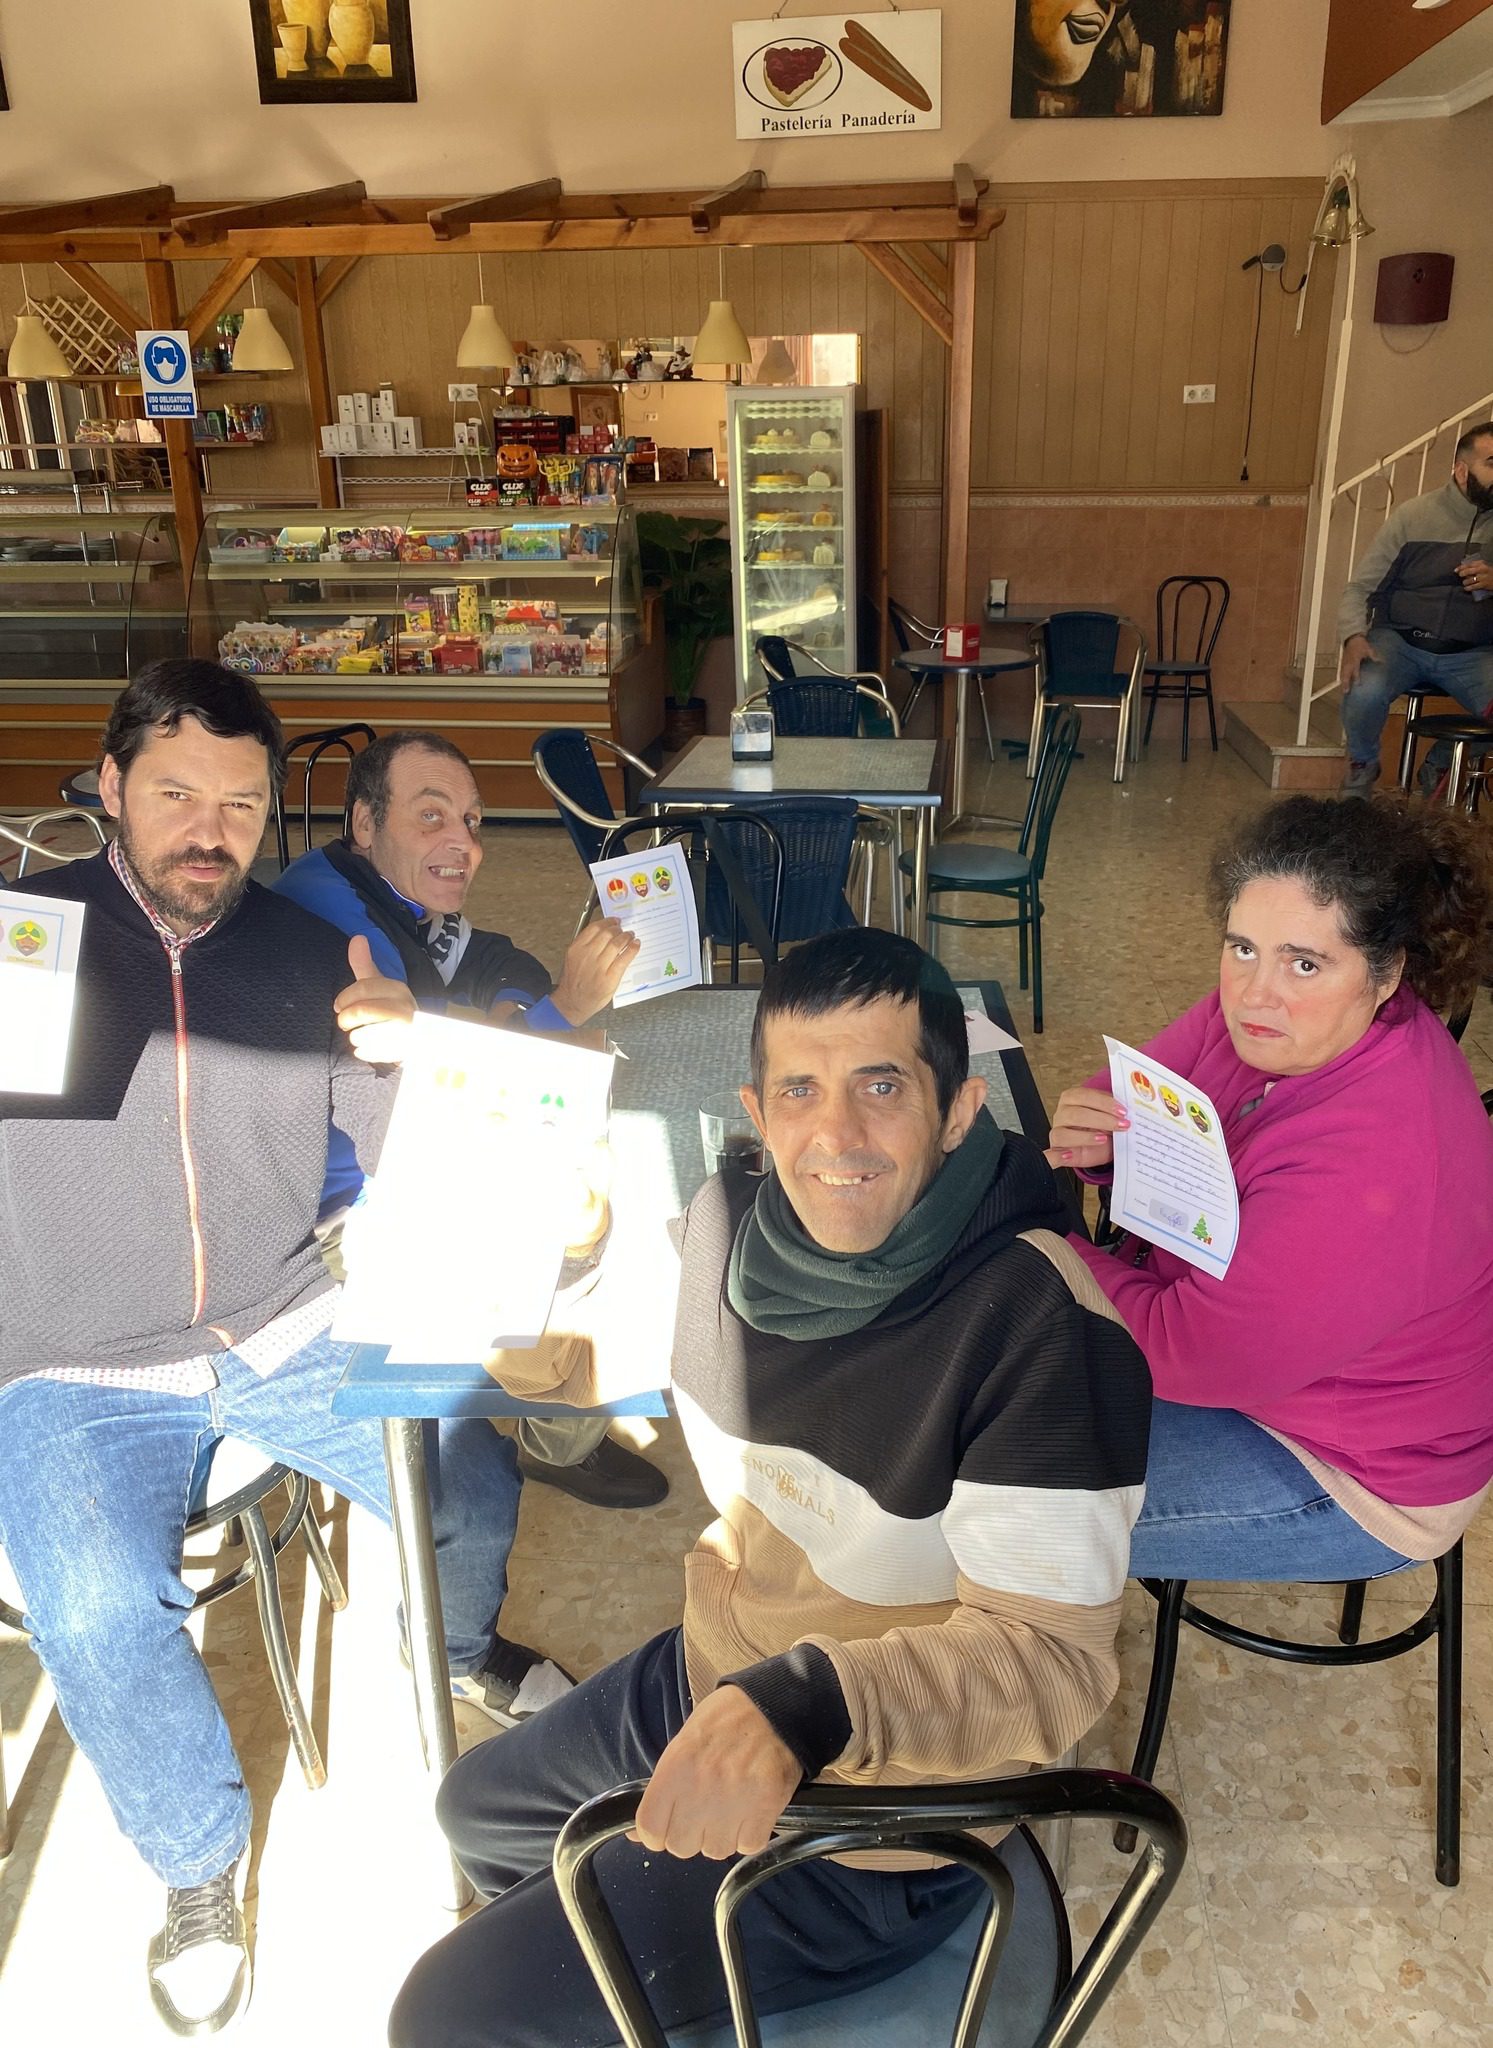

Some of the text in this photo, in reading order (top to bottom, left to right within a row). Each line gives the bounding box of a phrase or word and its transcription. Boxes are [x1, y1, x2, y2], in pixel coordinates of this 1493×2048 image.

[761, 110, 916, 132] Pastelería Panadería
[148, 395, 192, 404] USO OBLIGATORIO
[152, 404, 190, 412] DE MASCARILLA
[470, 483, 492, 491] CLIX
[502, 482, 524, 490] CLIX
